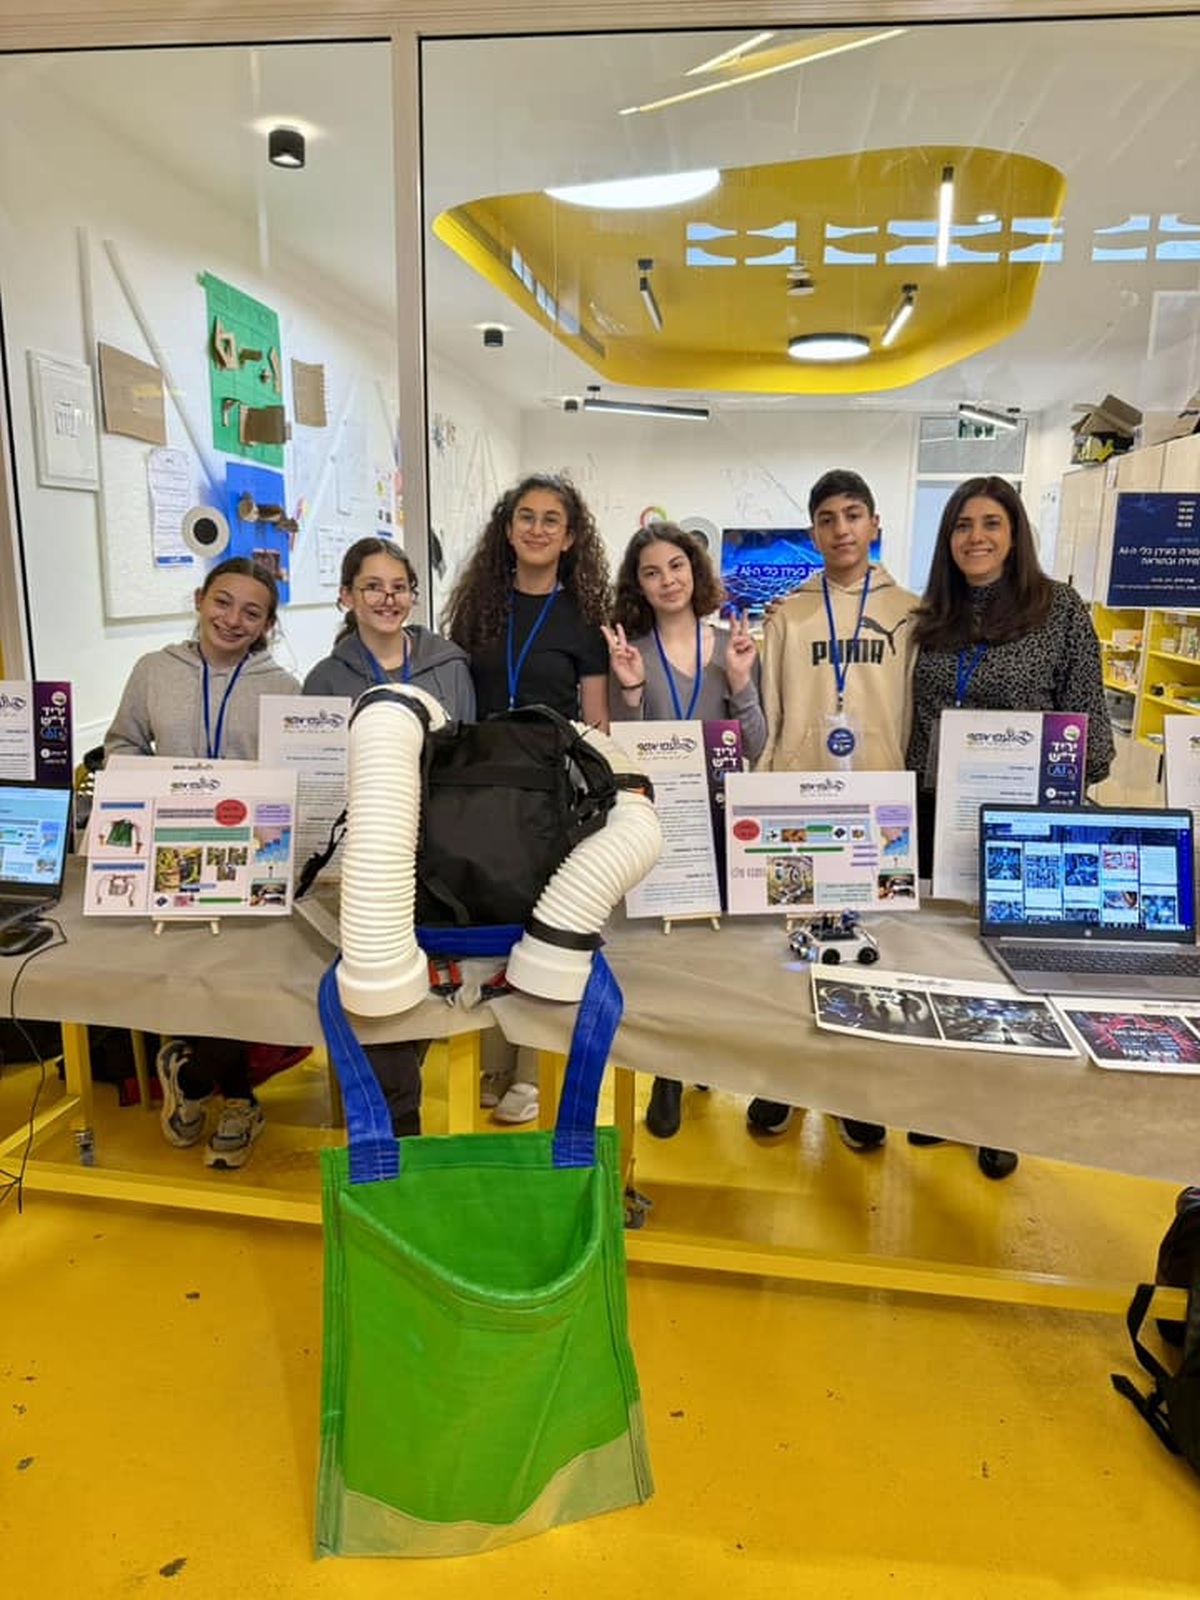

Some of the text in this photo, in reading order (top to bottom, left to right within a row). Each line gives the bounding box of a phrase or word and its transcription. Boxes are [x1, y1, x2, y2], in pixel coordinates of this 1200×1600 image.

[812, 638, 885, 666] PUMA
[41, 706, 65, 716] יריד
[1051, 741, 1079, 752] יריד
[713, 747, 737, 757] יריד
[1053, 765, 1067, 775] AI
